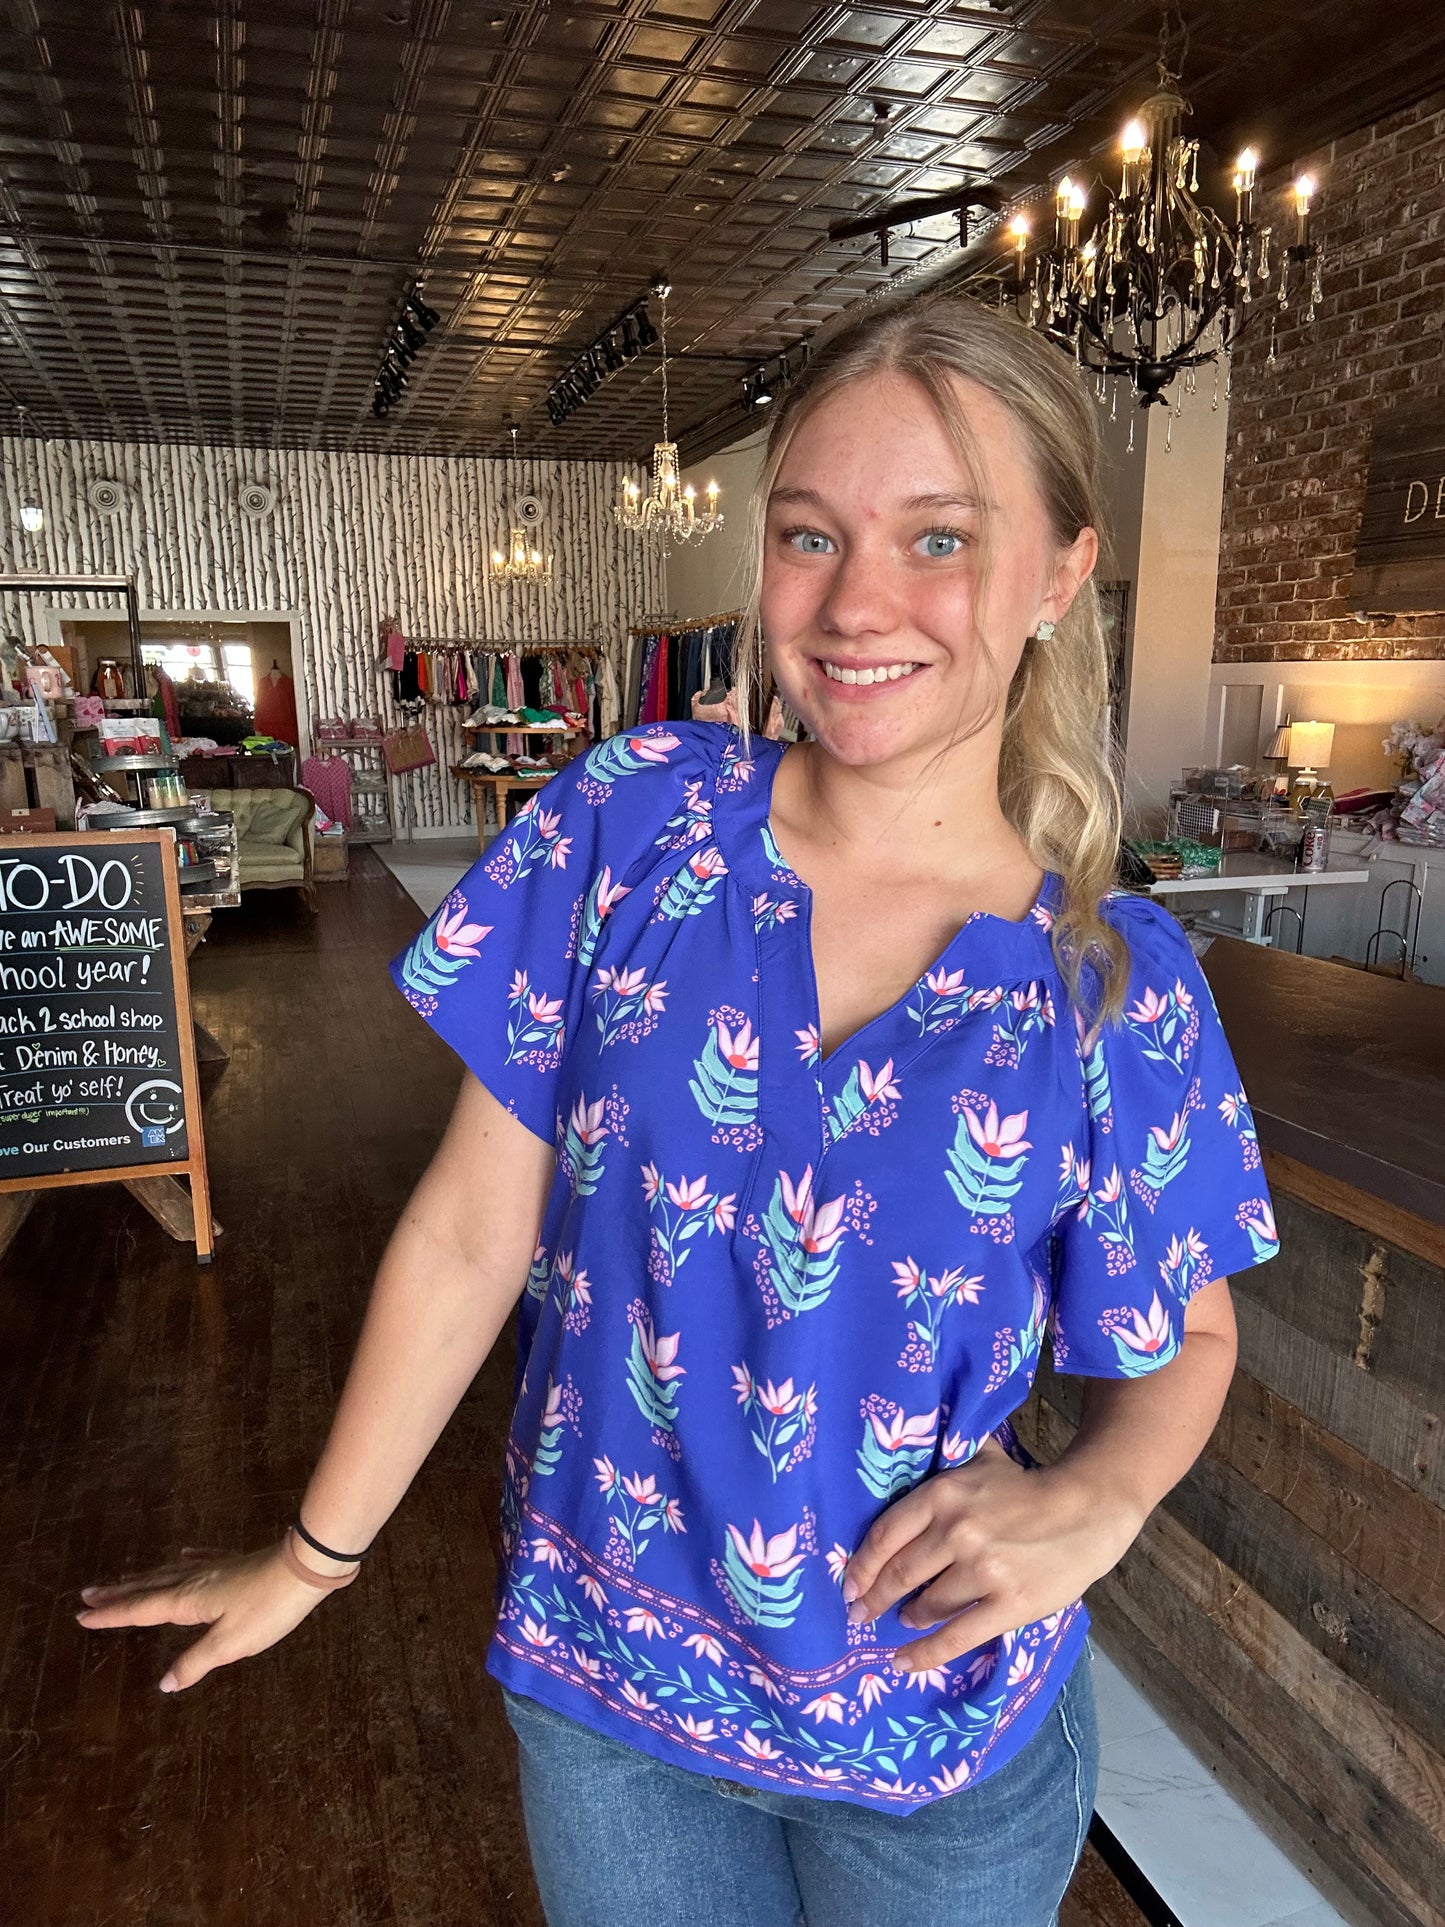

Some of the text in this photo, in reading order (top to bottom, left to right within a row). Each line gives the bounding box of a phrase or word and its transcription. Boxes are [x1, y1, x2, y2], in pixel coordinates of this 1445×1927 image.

[1302, 831, 1316, 867] Coke
[21, 930, 47, 948] an
[49, 917, 165, 949] AWESOME
[76, 954, 151, 991] year!
[39, 1006, 57, 1032] 2
[59, 1004, 115, 1030] school
[120, 1008, 163, 1030] shop
[16, 1045, 78, 1071] Denim
[82, 1040, 100, 1067] &
[79, 1075, 124, 1099] self!
[23, 1141, 50, 1154] Our
[53, 1135, 131, 1151] Customers
